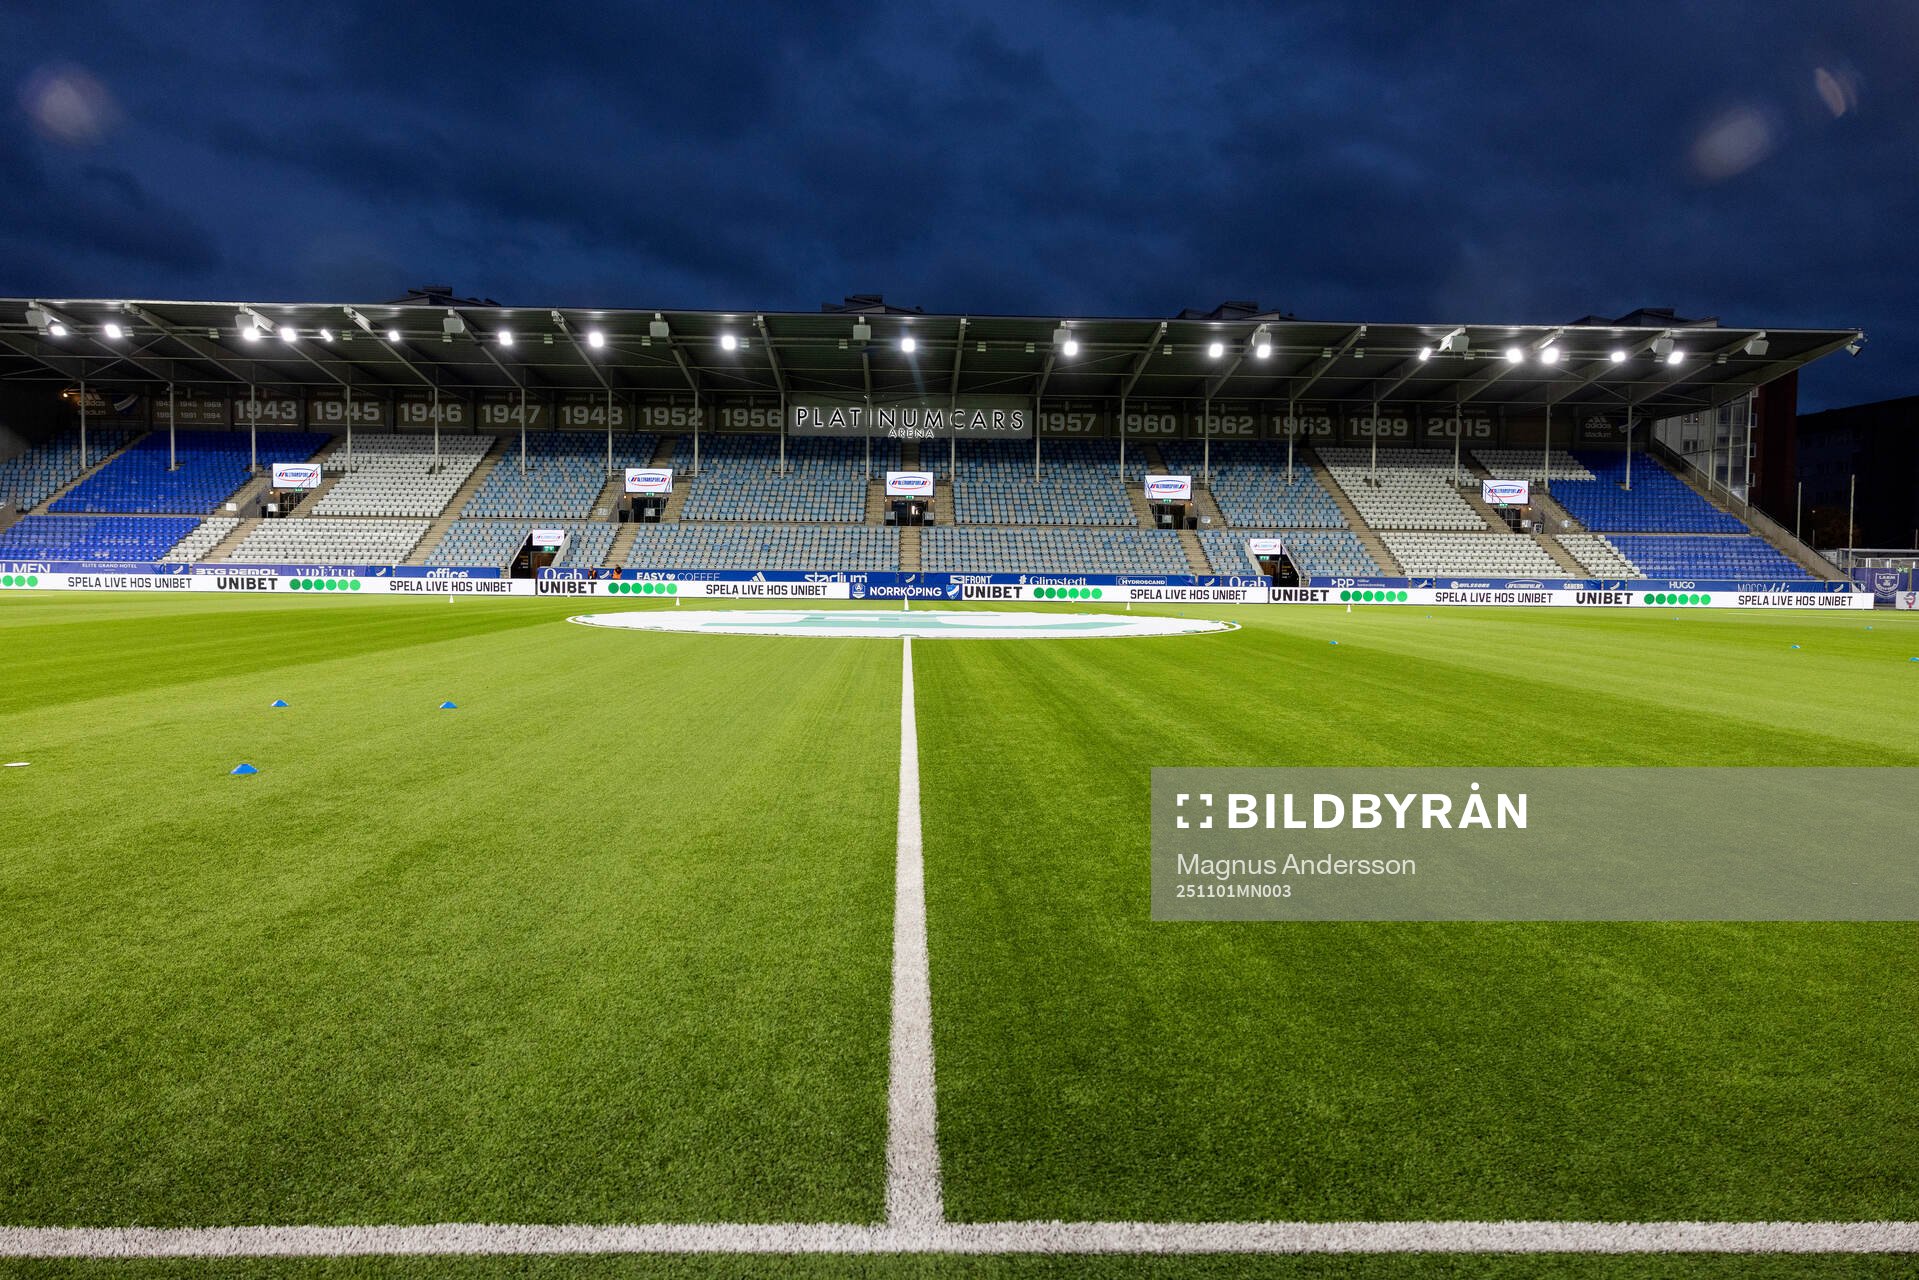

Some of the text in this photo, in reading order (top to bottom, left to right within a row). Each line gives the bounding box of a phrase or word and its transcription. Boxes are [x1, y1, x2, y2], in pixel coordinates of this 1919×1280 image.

[235, 401, 297, 420] 1943
[313, 402, 380, 421] 1945
[400, 403, 462, 422] 1946
[482, 404, 541, 424] 1947
[643, 407, 703, 426] 1952
[722, 408, 782, 427] 1956
[1039, 413, 1097, 432] 1957
[1116, 414, 1176, 433] 1960
[1195, 415, 1254, 434] 1962
[1350, 417, 1408, 436] 1989
[1428, 418, 1491, 437] 2015
[888, 428, 935, 438] ARENA
[0, 563, 50, 573] LMEN
[427, 568, 469, 578] office
[544, 569, 583, 579] Ocab
[637, 572, 665, 580] EASY
[805, 572, 868, 582] stadium
[966, 575, 992, 584] FRONT
[1030, 576, 1086, 585] Glimstedt
[1229, 577, 1267, 587] Ocab
[68, 577, 192, 588] SPELA LIVE HOS UNIBET
[217, 577, 278, 590] UNIBET
[390, 581, 513, 593] SPELA LIVE HOS UNIBET
[540, 581, 597, 594] UNIBET
[1338, 579, 1354, 588] RP
[1669, 581, 1695, 589] HUGO
[706, 584, 827, 596] SPELA LIVE HOS UNIBET
[870, 585, 942, 598] NORRKÖPING
[965, 586, 1023, 598] UNIBET
[1131, 589, 1247, 601] SPELA LIVE HOS UNIBET
[1272, 589, 1329, 602] UNIBET
[1436, 592, 1553, 603] SPELA LIVE HOS UNIBET
[1576, 592, 1634, 604] UNIBET
[1739, 595, 1853, 606] SPELA LIVE HOS UNIBET
